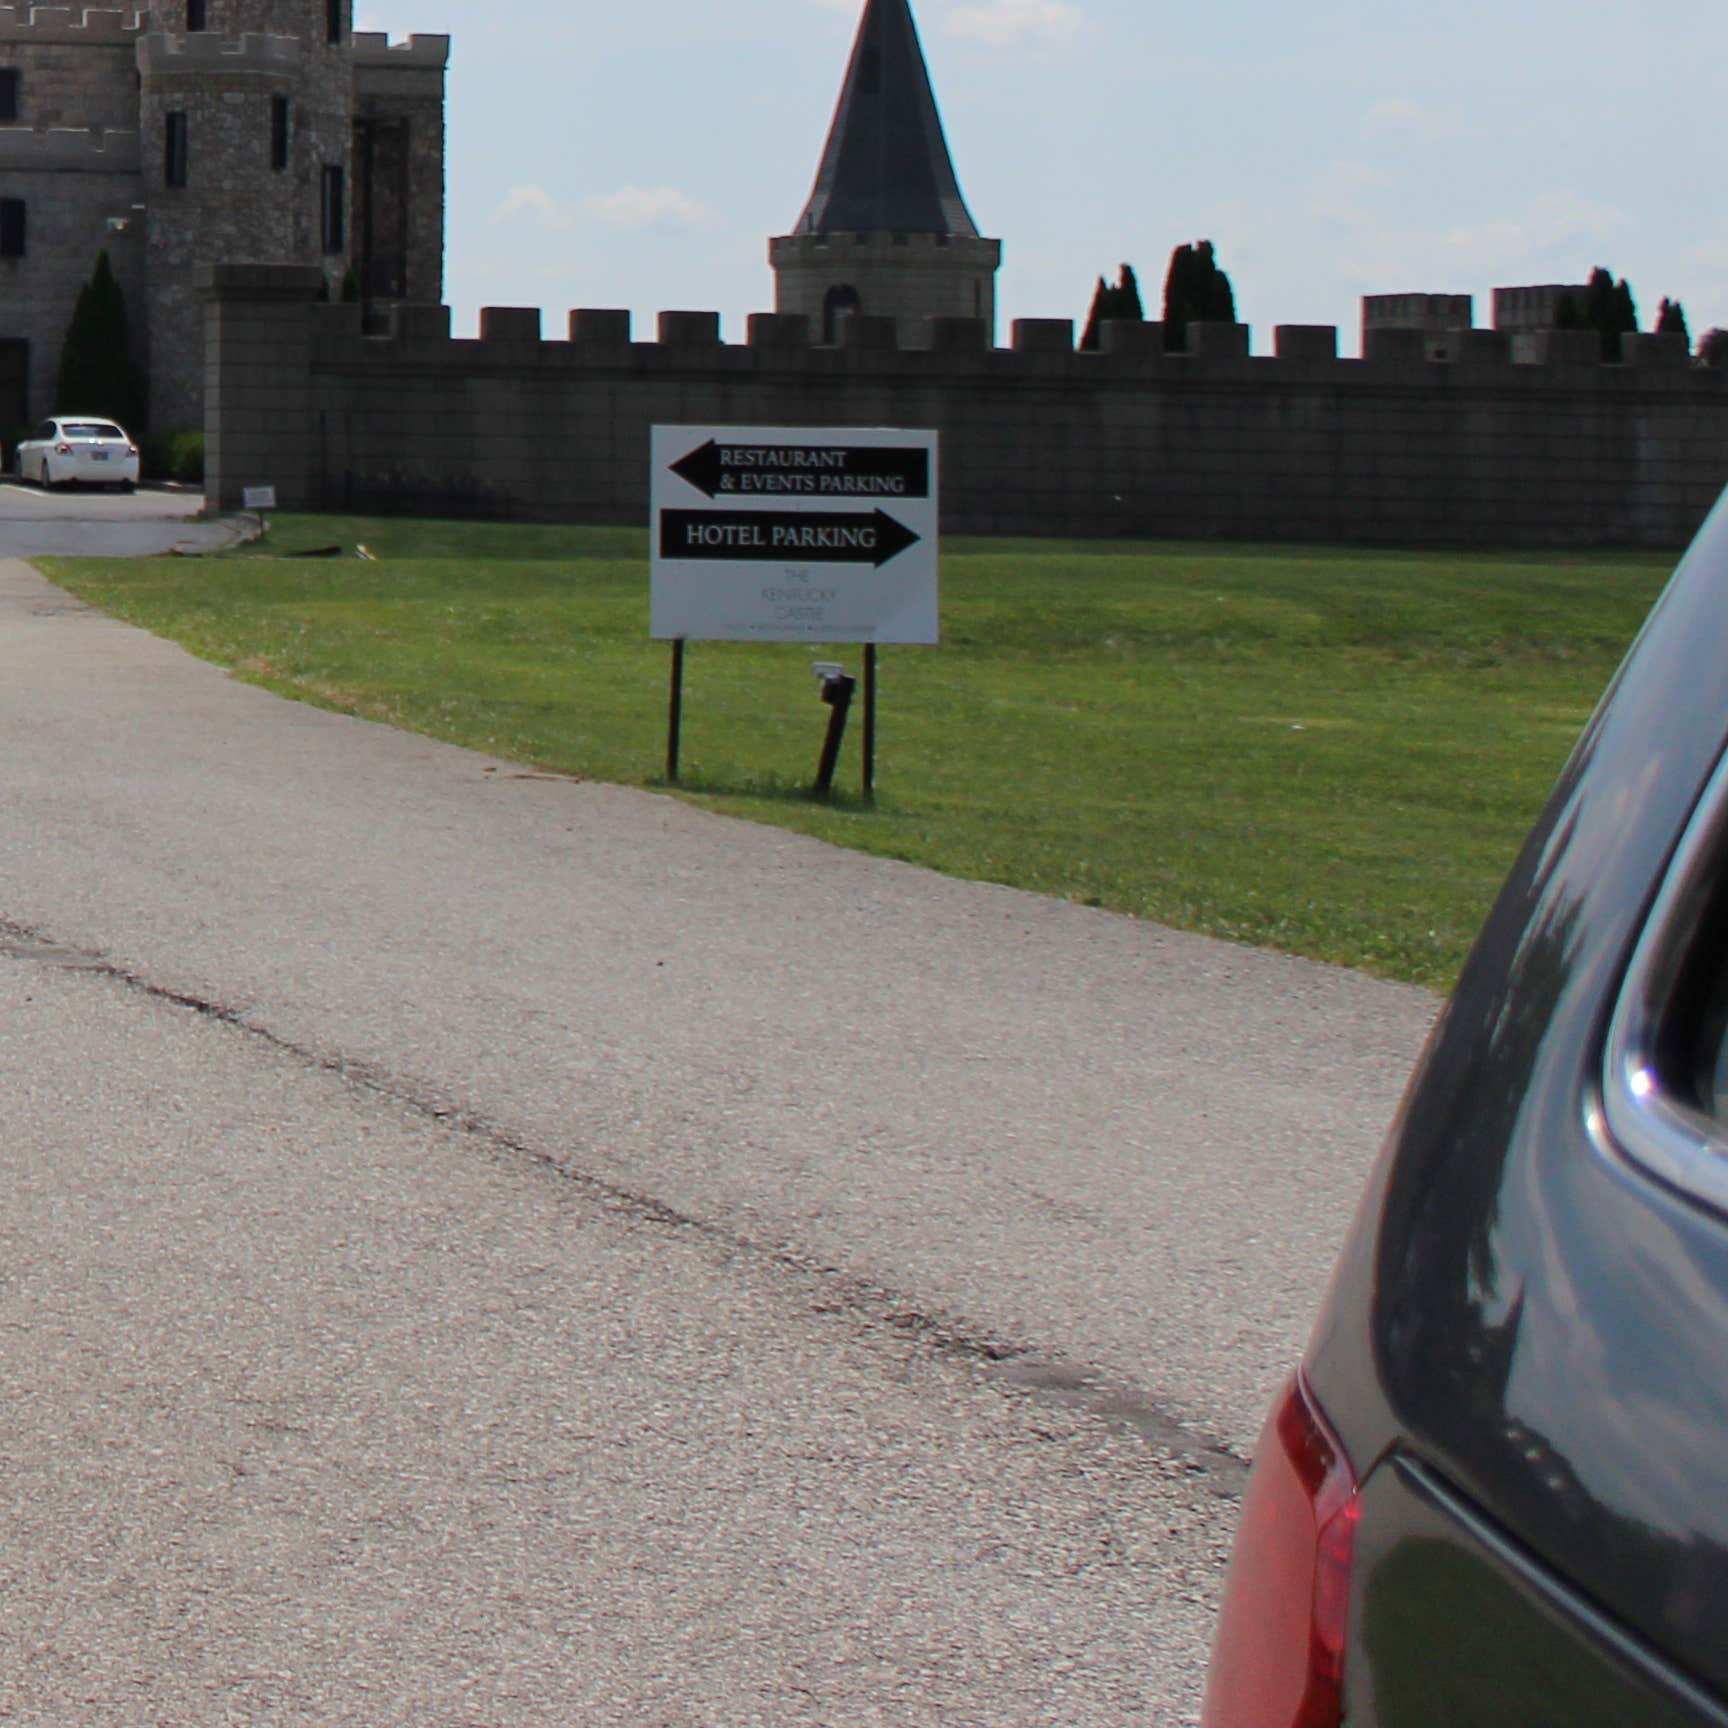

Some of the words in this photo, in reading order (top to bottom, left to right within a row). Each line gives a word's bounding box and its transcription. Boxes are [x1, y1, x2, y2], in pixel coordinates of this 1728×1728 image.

[720, 449, 847, 468] RESTAURANT
[720, 474, 734, 490] &
[741, 474, 814, 491] EVENTS
[819, 475, 905, 493] PARKING
[687, 524, 766, 546] HOTEL
[772, 526, 877, 548] PARKING
[784, 568, 809, 583] THE
